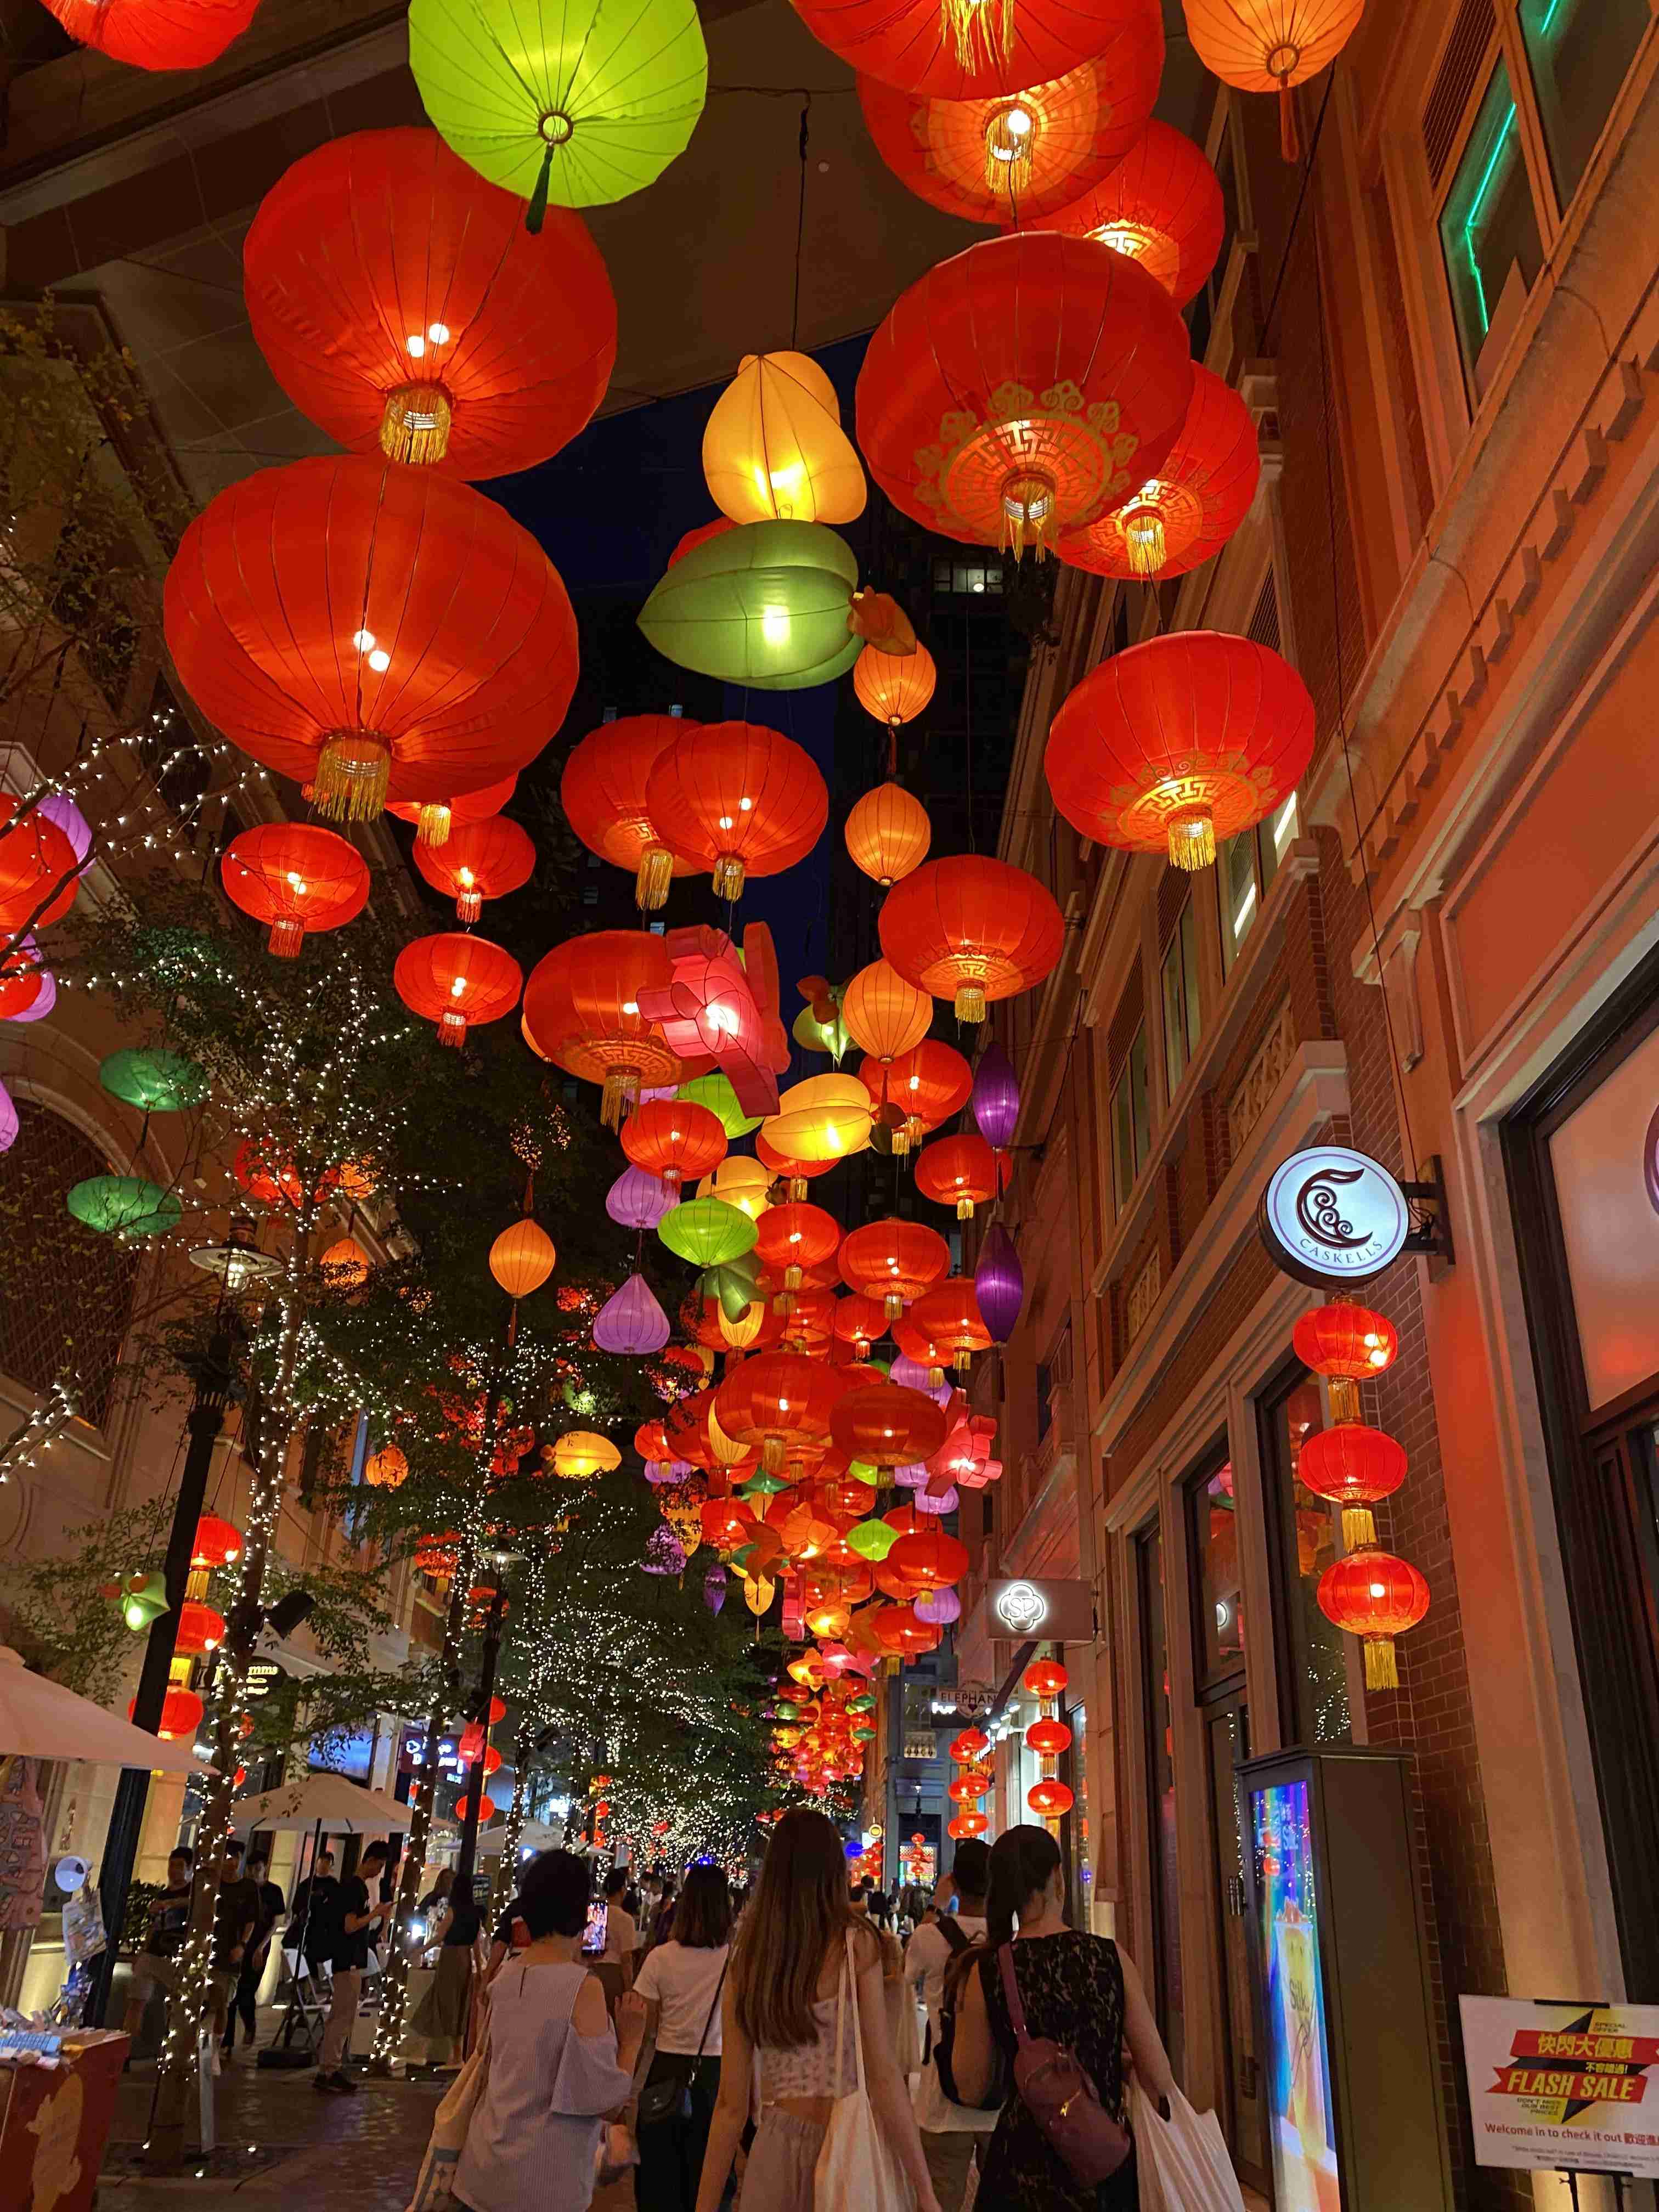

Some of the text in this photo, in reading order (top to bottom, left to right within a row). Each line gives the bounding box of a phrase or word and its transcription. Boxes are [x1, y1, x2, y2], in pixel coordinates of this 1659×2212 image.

[1299, 1238, 1383, 1264] CASKELLS
[1009, 1598, 1035, 1618] SP
[941, 1692, 997, 1704] ELEPHAN
[1538, 2033, 1634, 2058] 快閃大優惠
[1507, 2071, 1636, 2100] FLASH SALE
[1485, 2123, 1659, 2146] Welcome in to check it out 歡迎進
